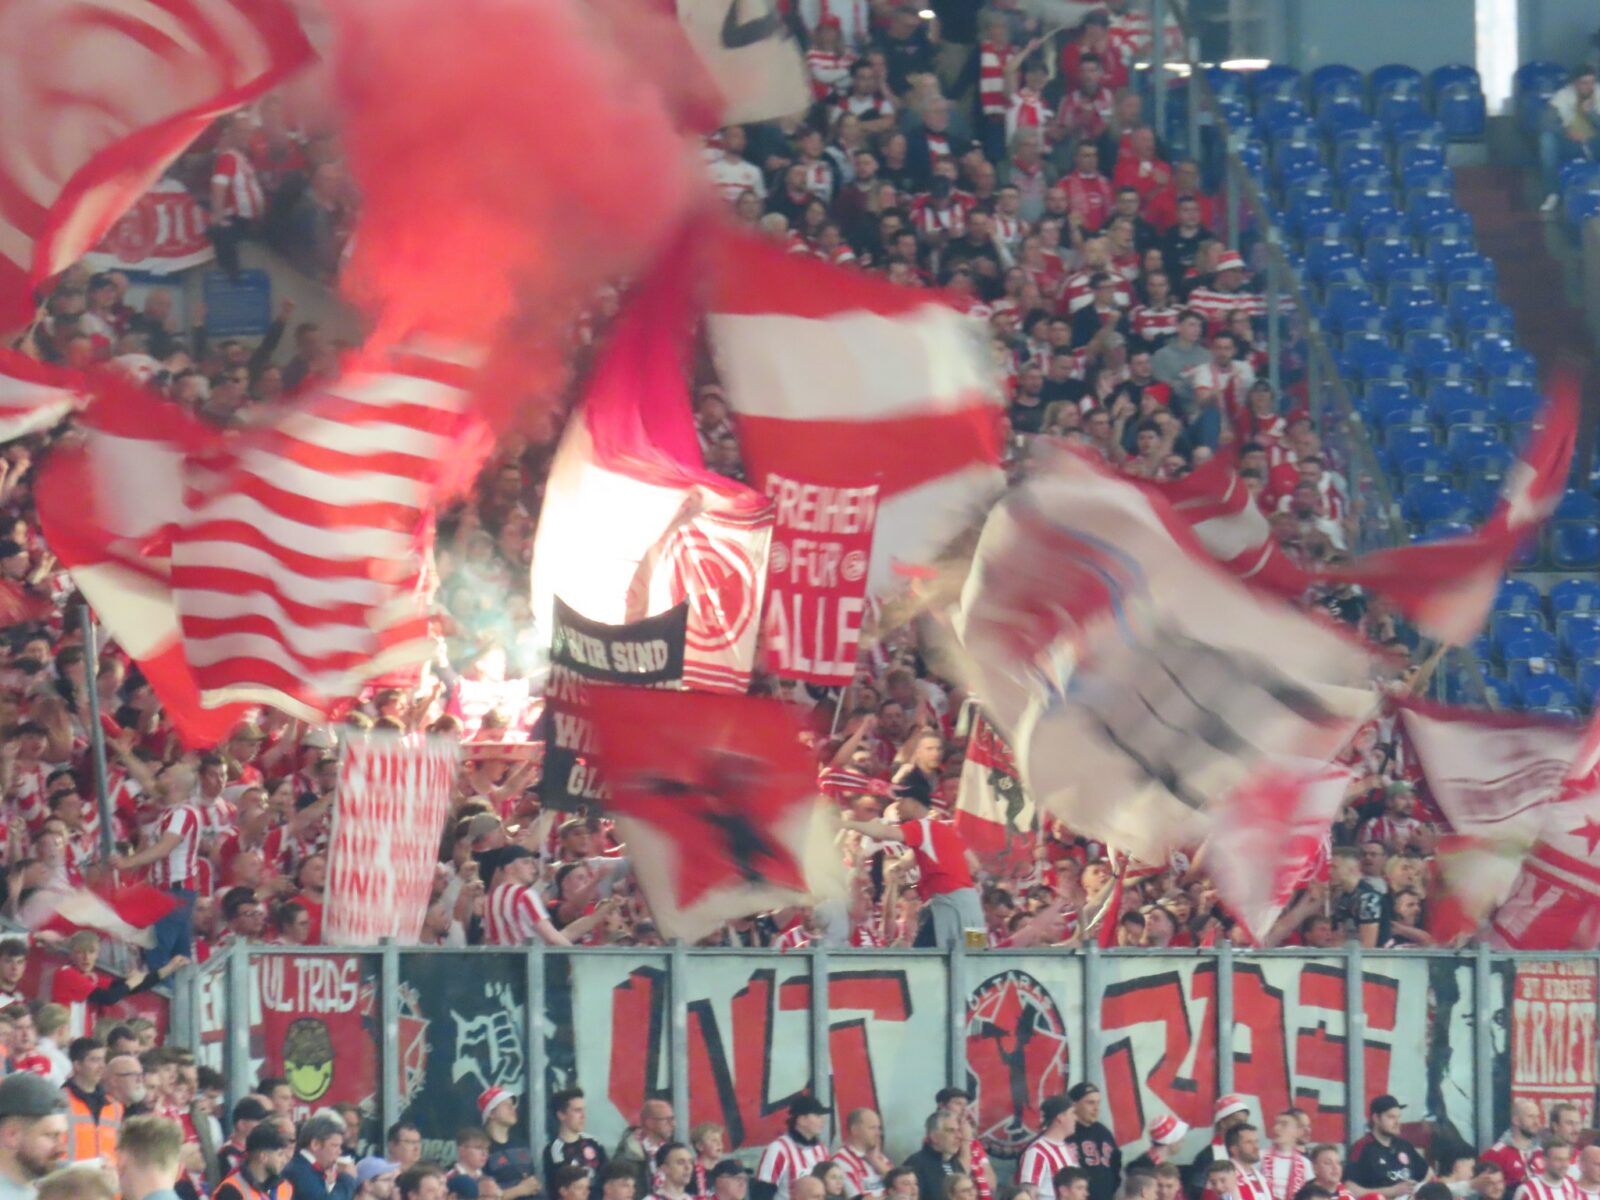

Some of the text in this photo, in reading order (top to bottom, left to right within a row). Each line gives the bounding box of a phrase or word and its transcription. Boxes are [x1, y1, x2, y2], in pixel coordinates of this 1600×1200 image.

[611, 639, 669, 673] SIND
[766, 589, 866, 677] ALLE
[262, 956, 360, 1013] ULTRAS
